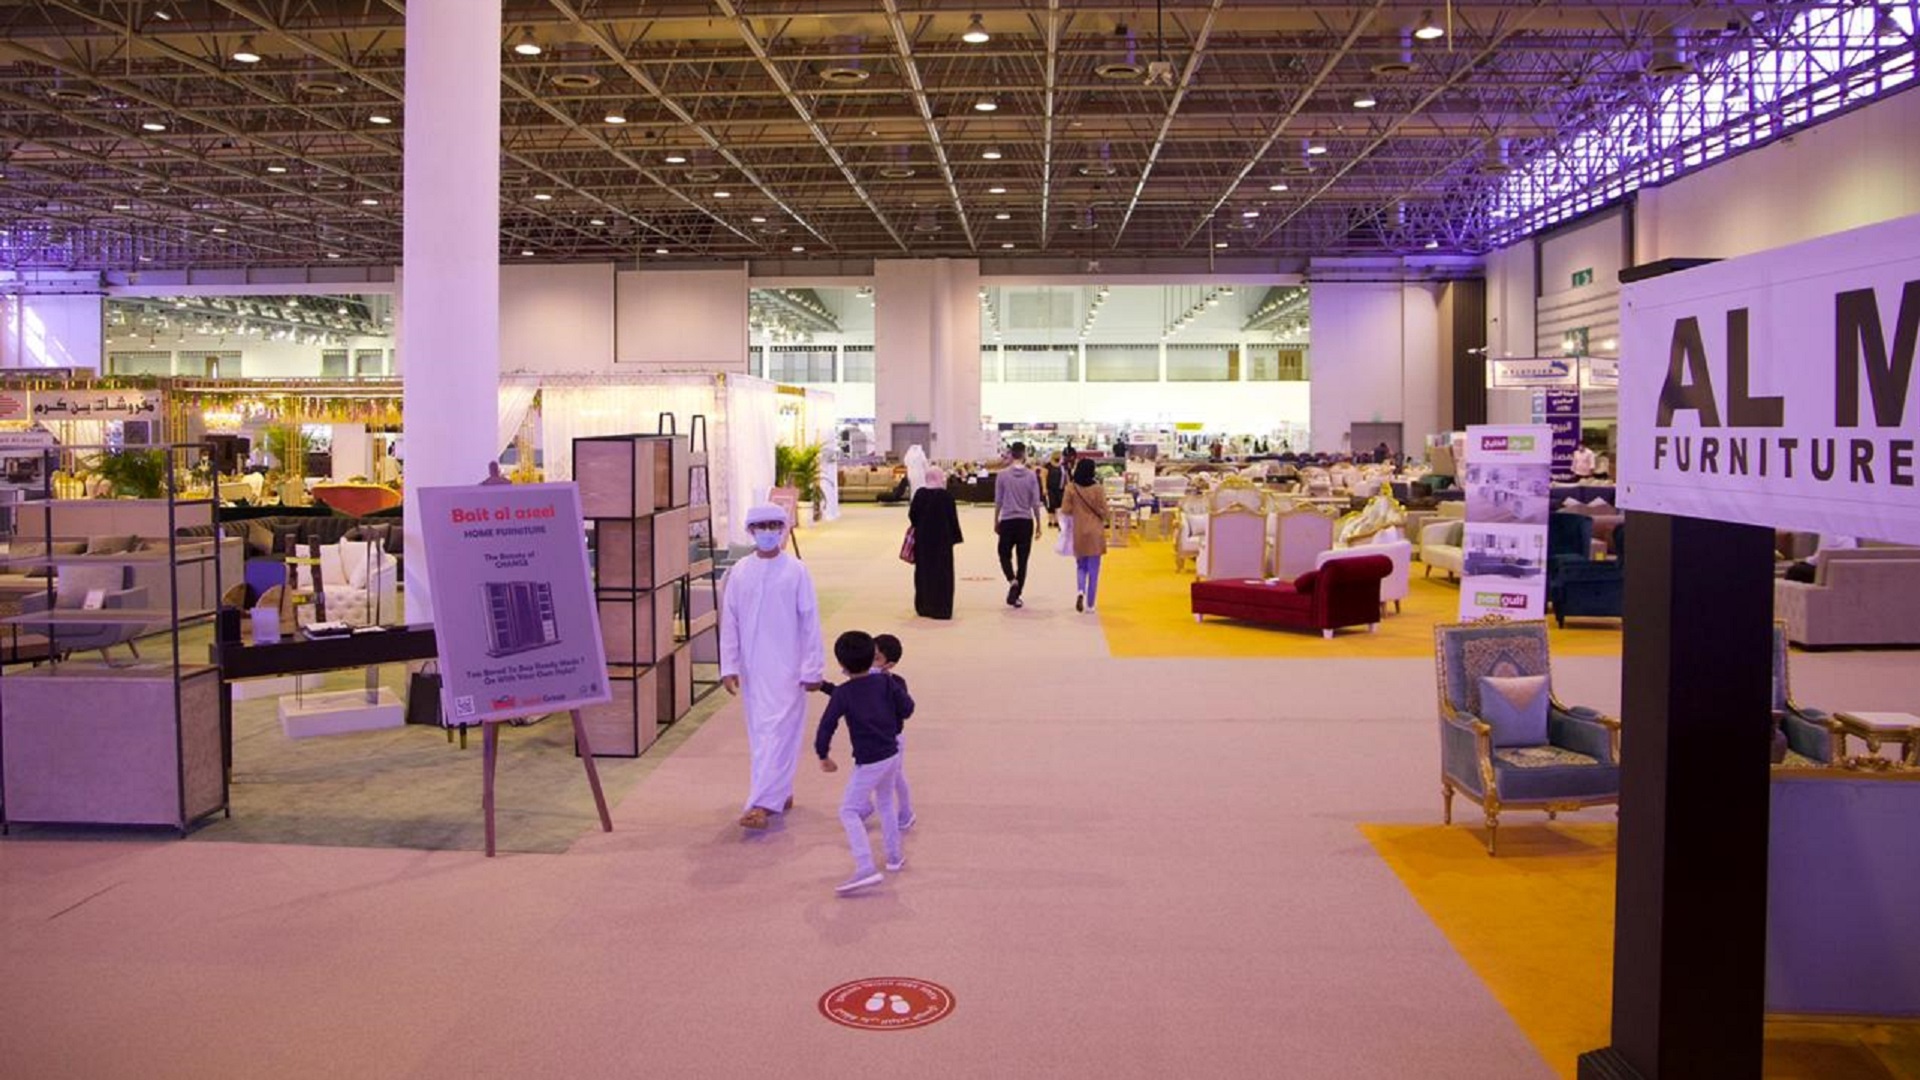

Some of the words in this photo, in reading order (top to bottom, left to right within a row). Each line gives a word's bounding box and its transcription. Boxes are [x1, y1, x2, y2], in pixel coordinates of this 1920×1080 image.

[1655, 306, 1785, 428] AL
[34, 397, 67, 415] كرم
[1653, 436, 1914, 487] FURNITURE
[451, 508, 490, 522] Bait
[494, 506, 510, 520] al
[515, 504, 555, 519] aseel
[464, 528, 493, 538] HOME
[496, 525, 546, 536] FURNITURE
[484, 553, 498, 561] The
[494, 559, 529, 568] CHANGE
